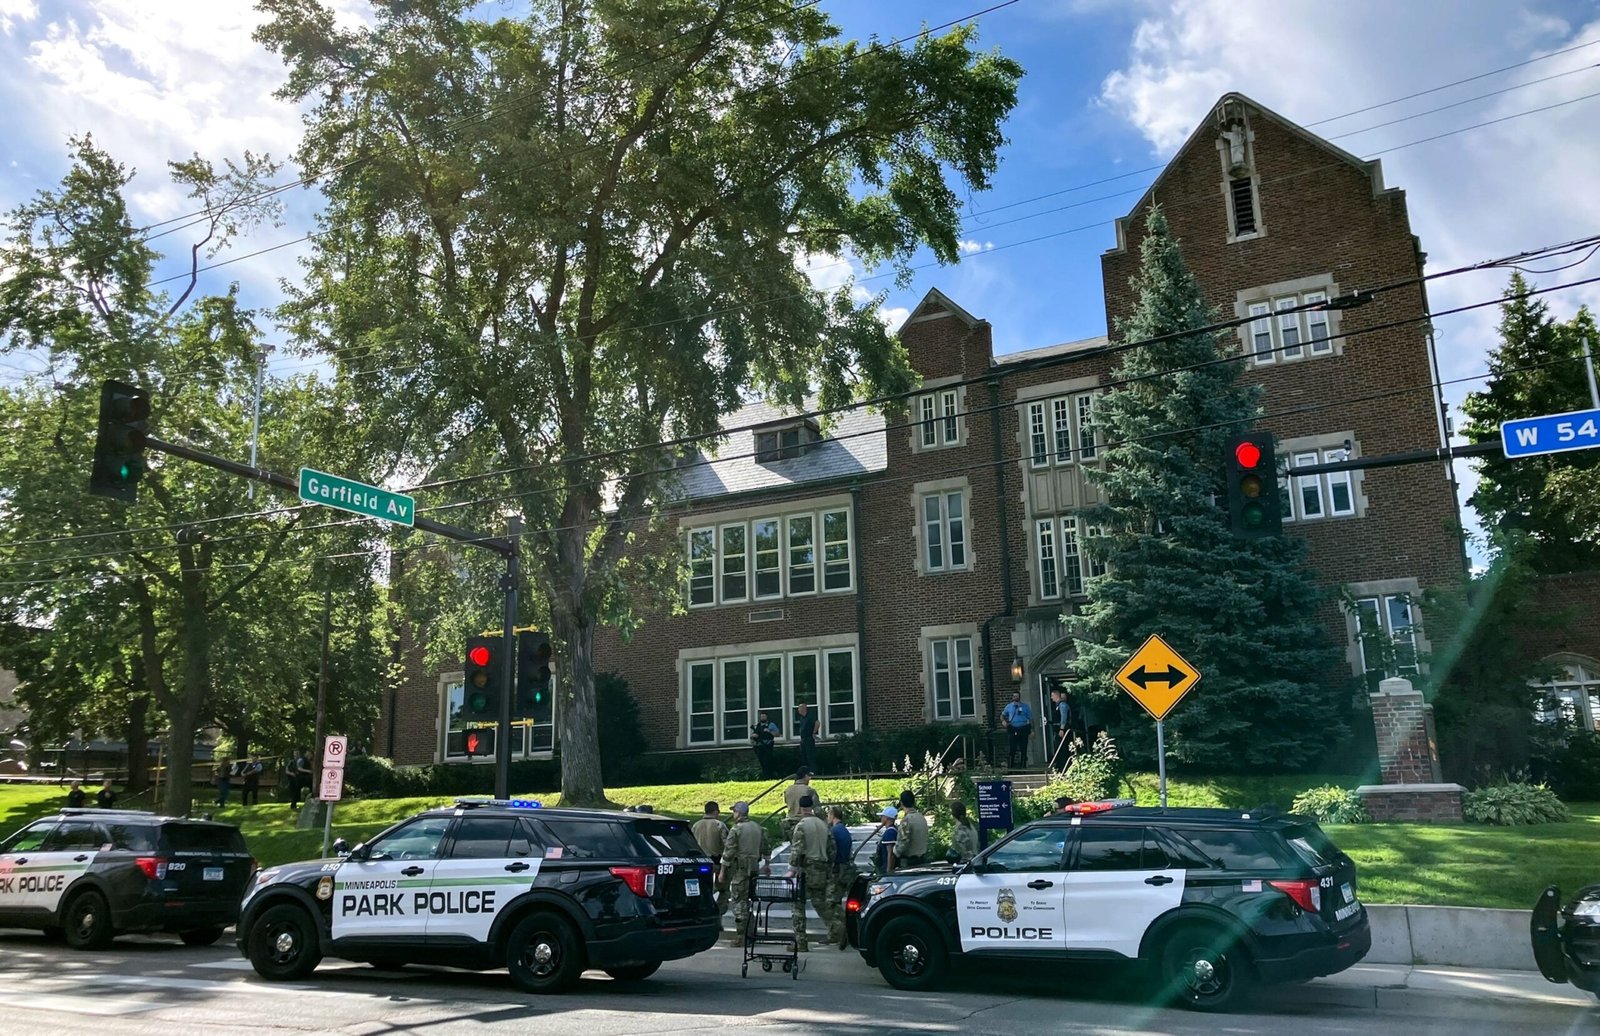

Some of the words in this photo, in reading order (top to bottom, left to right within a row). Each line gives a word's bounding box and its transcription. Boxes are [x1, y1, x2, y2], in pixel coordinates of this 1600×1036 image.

[1516, 427, 1538, 447] W
[1557, 419, 1598, 442] 54
[308, 478, 378, 510] Garfield
[387, 499, 407, 517] Av
[168, 862, 186, 871] 820
[321, 863, 341, 872] 850
[657, 864, 674, 875] 850
[19, 875, 65, 893] POLICE
[344, 880, 396, 890] MINNEAPOLIS
[937, 876, 956, 885] 431
[1320, 876, 1334, 888] 431
[342, 893, 405, 917] PARK
[414, 890, 496, 915] POLICE
[970, 927, 1053, 940] POLICE
